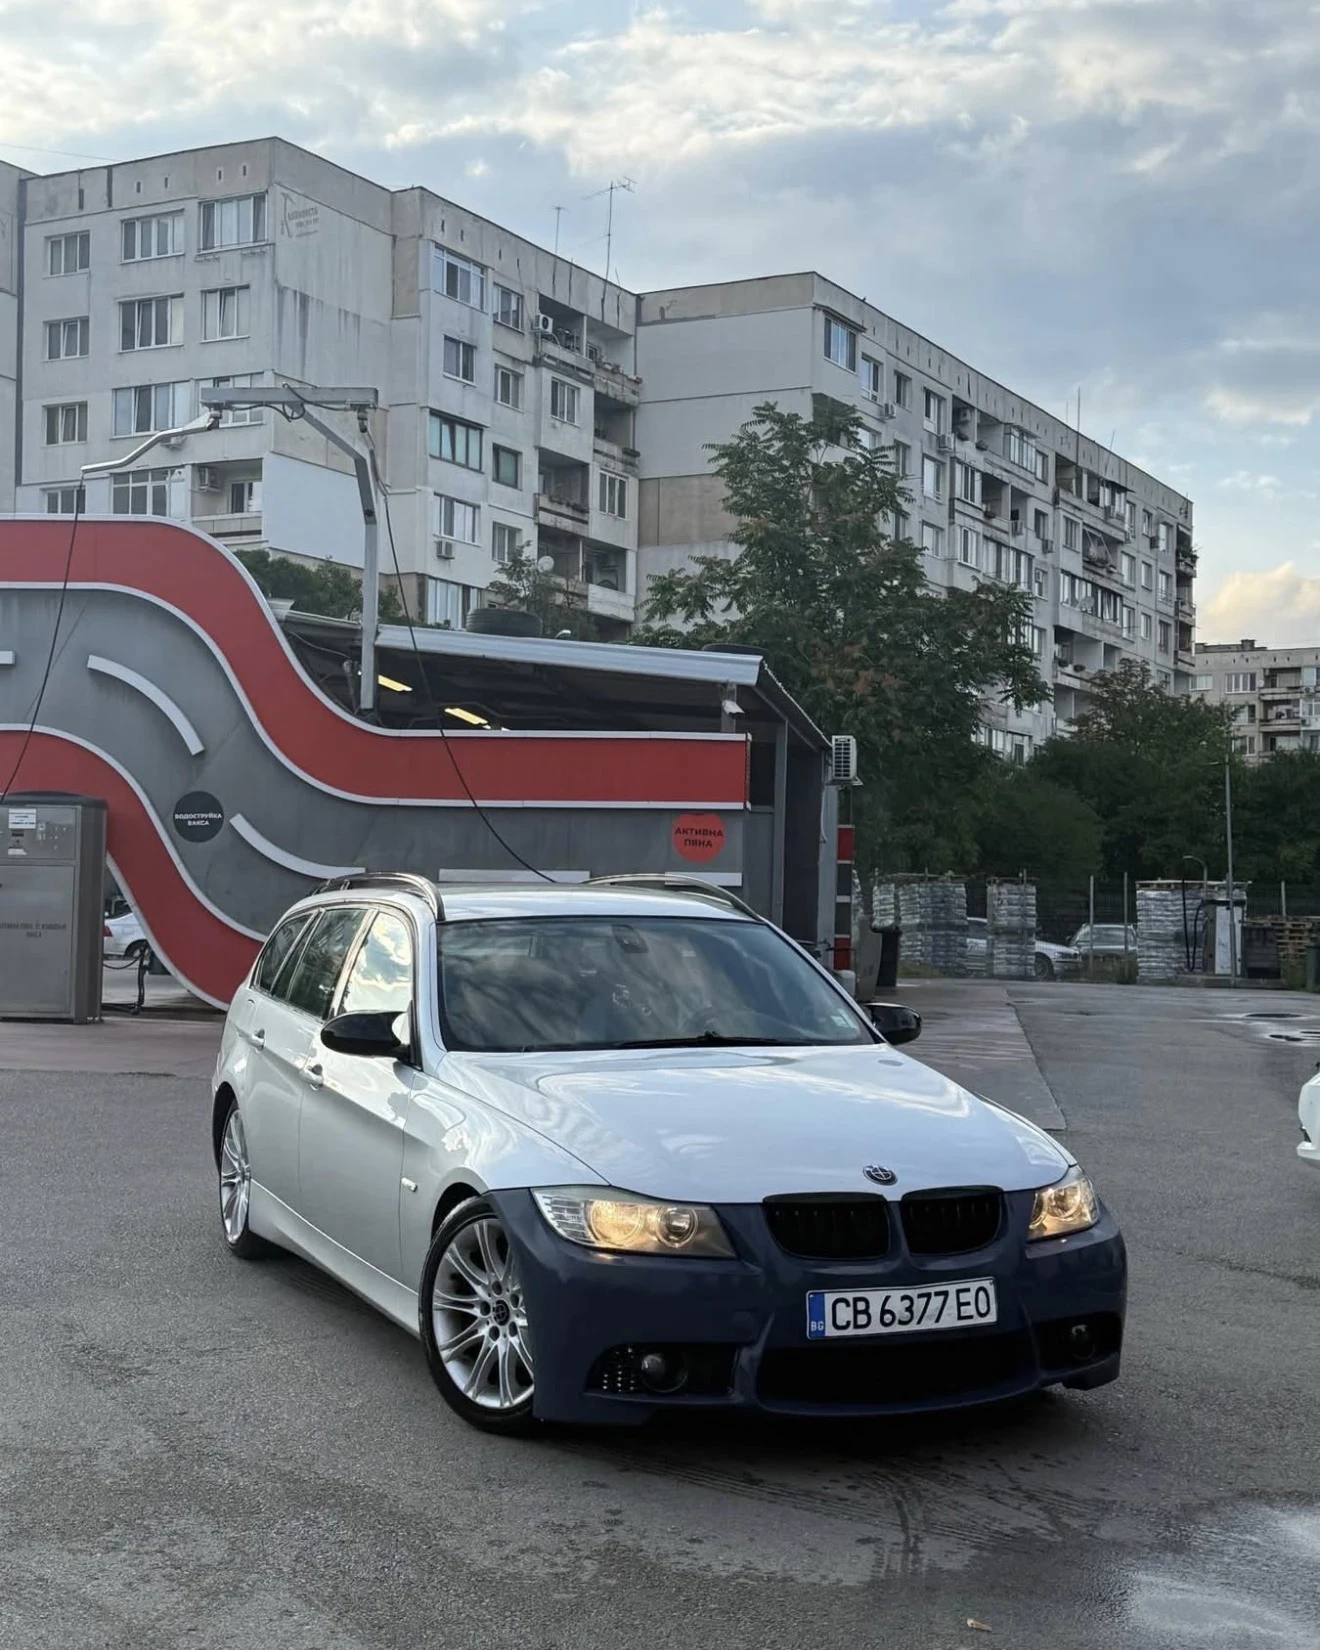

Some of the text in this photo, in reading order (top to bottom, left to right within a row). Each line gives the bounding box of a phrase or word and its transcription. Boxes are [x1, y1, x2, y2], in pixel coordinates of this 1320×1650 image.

[174, 811, 222, 820] ВОДОСТРУЙКА
[674, 827, 724, 837] АКТИВНА
[810, 1321, 824, 1331] BG
[831, 1296, 872, 1331] CB
[879, 1290, 949, 1328] 6377
